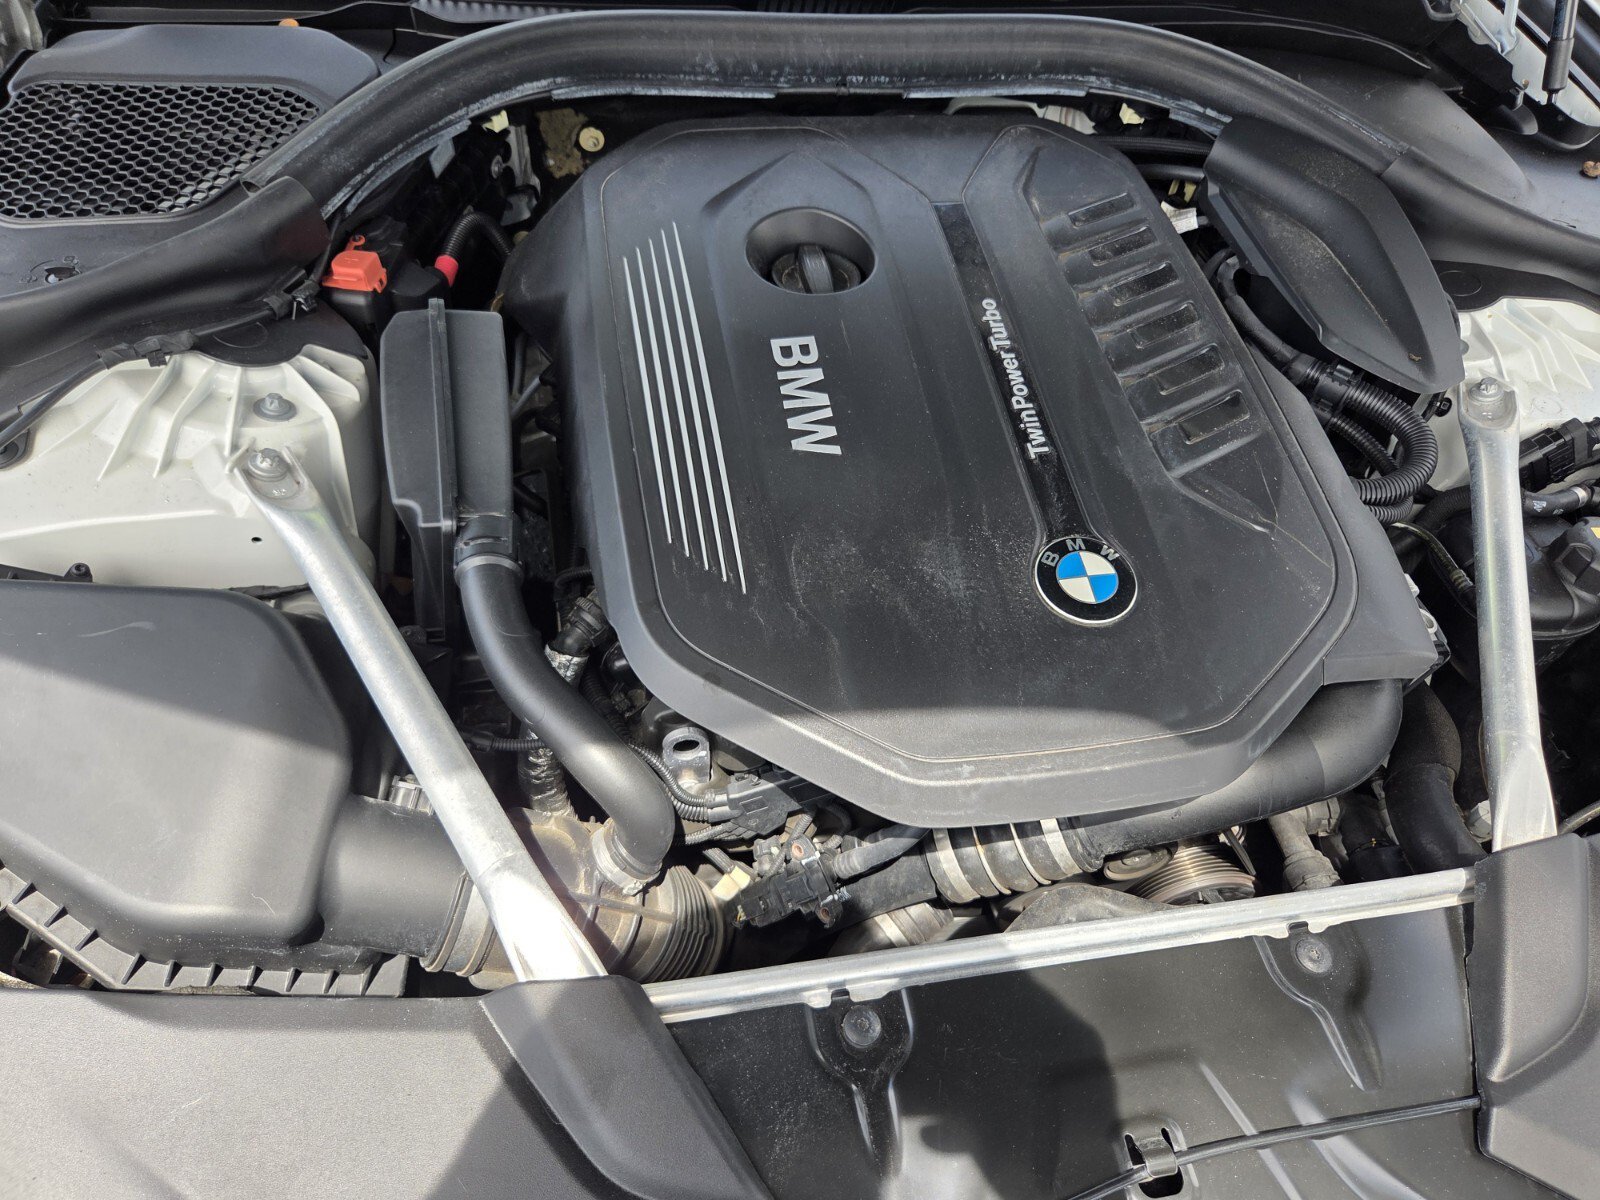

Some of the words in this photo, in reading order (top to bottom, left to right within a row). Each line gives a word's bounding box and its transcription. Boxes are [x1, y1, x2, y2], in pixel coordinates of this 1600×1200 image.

[981, 298, 1011, 351] Turbo
[770, 335, 842, 455] BMW
[1000, 350, 1050, 460] TwinPower
[1040, 538, 1120, 567] BMW
